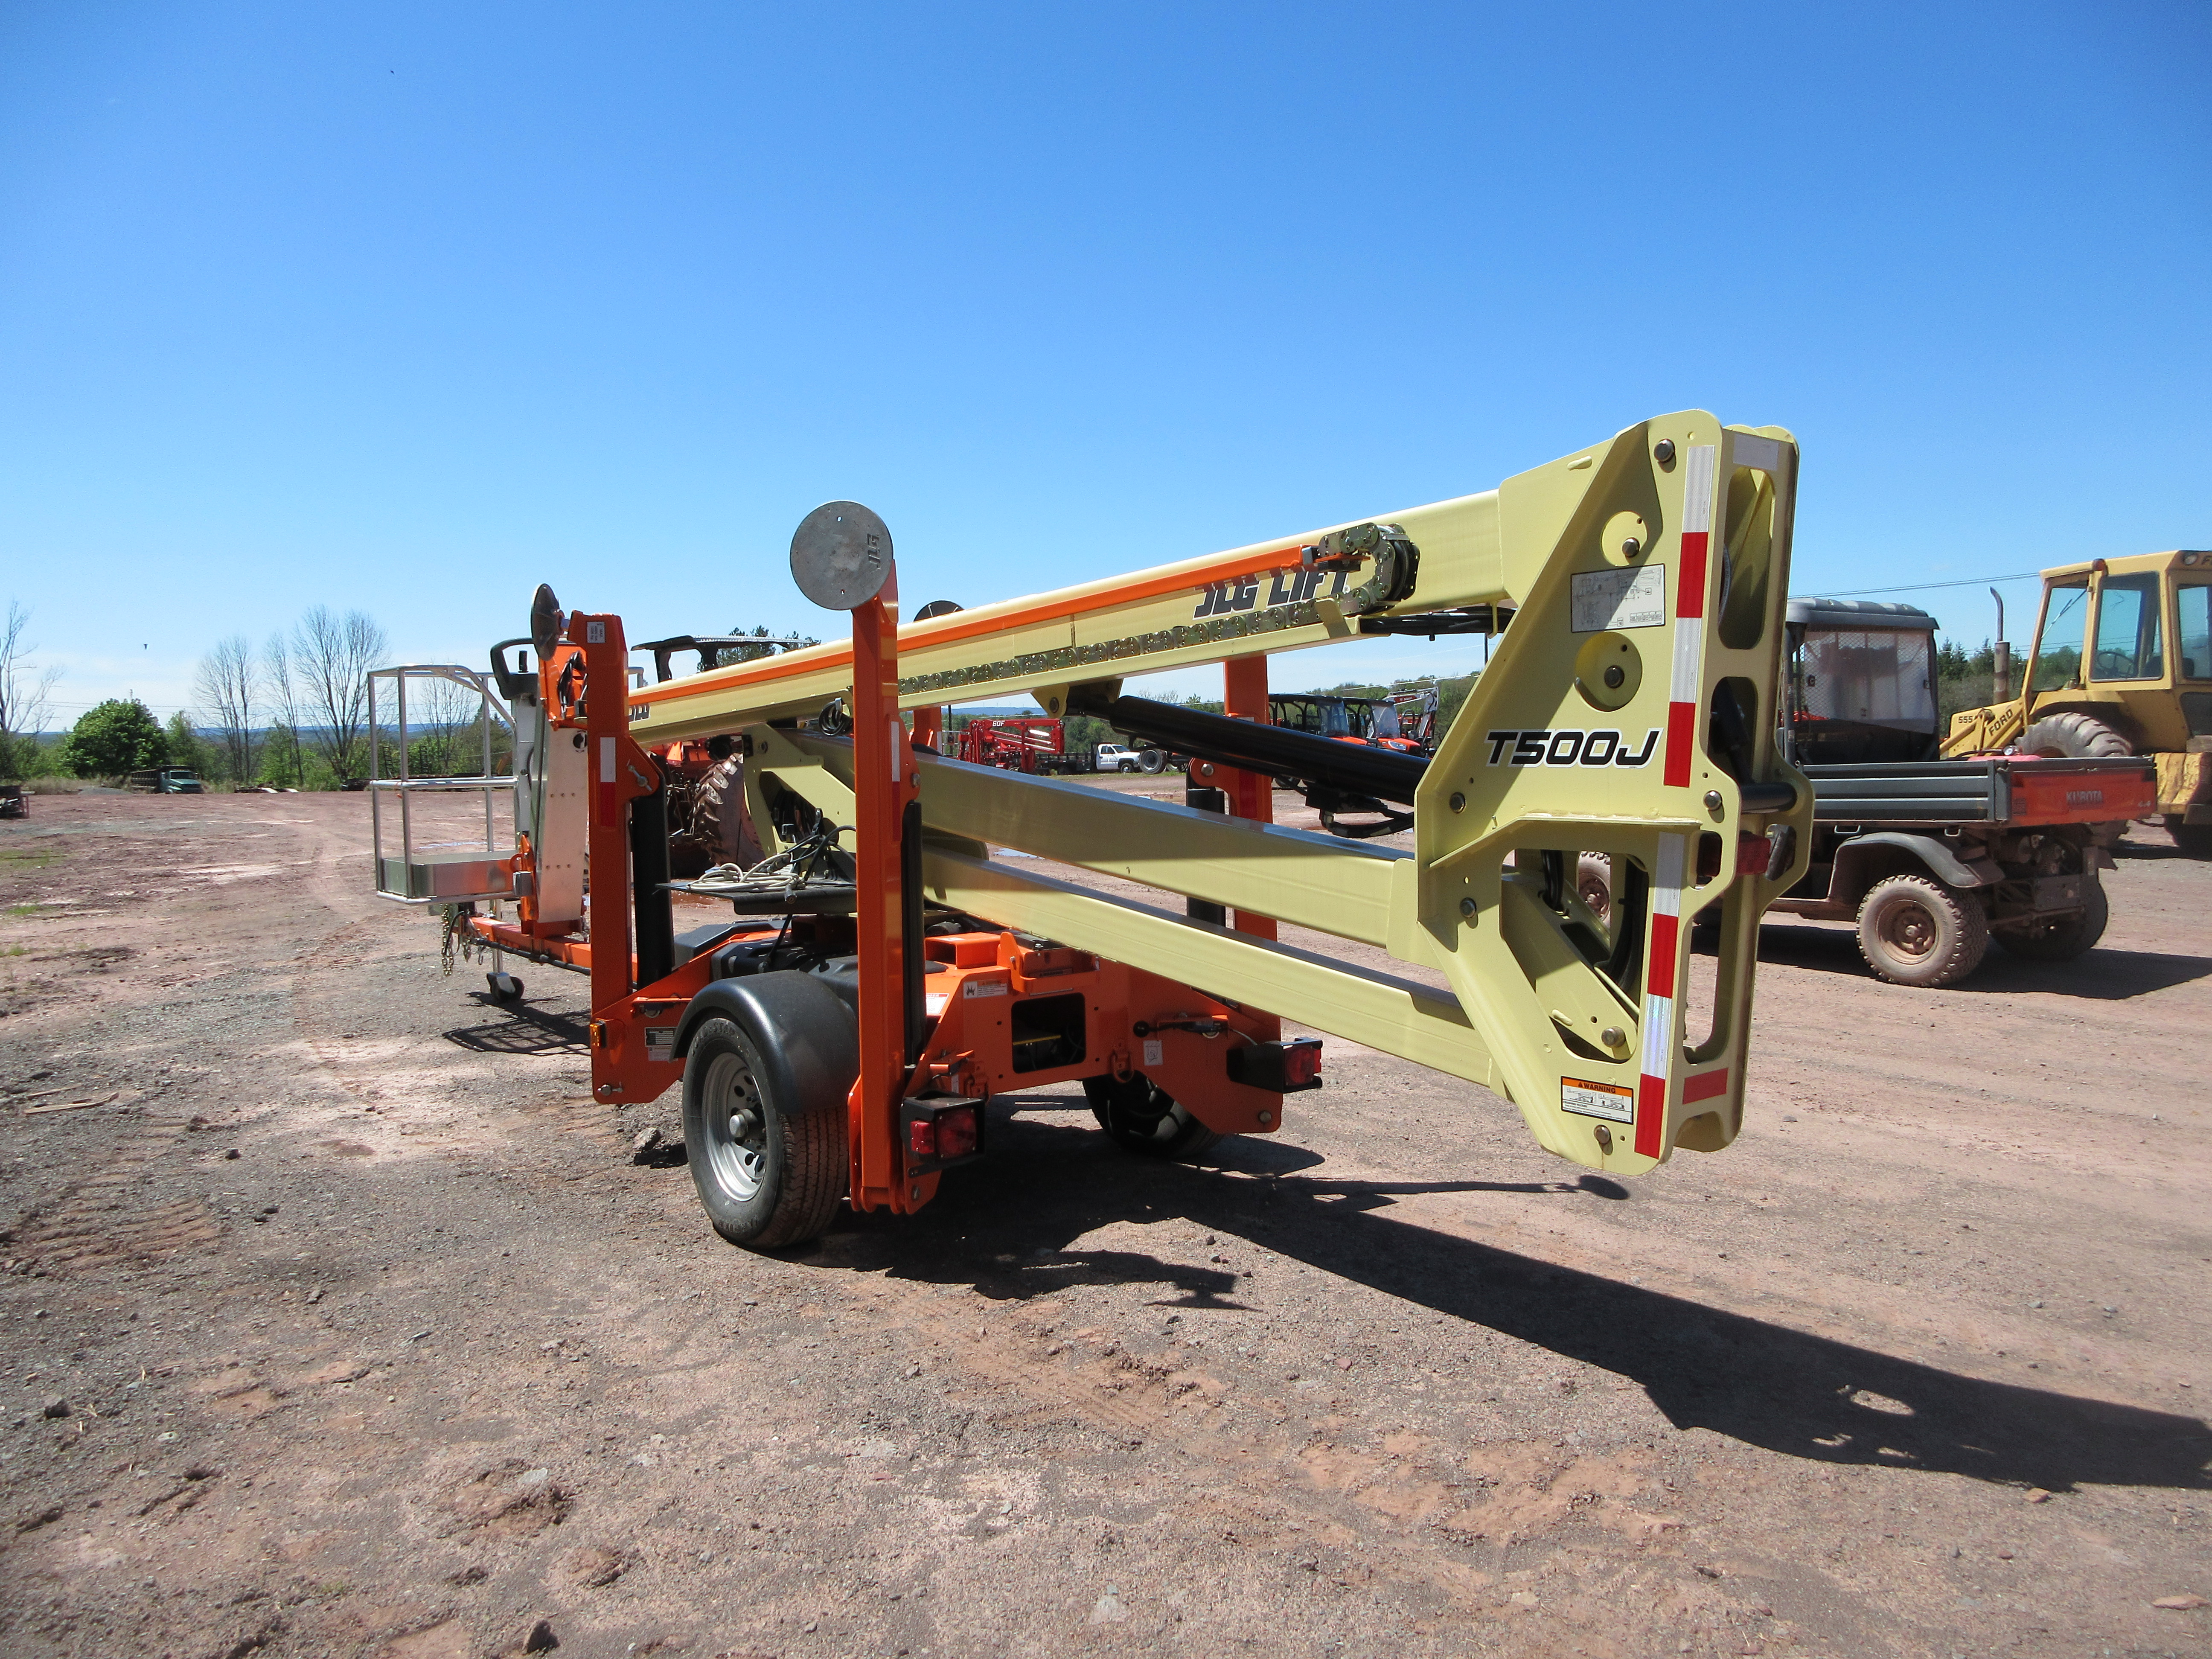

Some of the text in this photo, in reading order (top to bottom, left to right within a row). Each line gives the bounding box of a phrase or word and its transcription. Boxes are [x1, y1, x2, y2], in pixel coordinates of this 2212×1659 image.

[1988, 709, 2013, 737] FORD
[1487, 731, 1660, 766] T500J
[1583, 1083, 1616, 1094] WARNING
